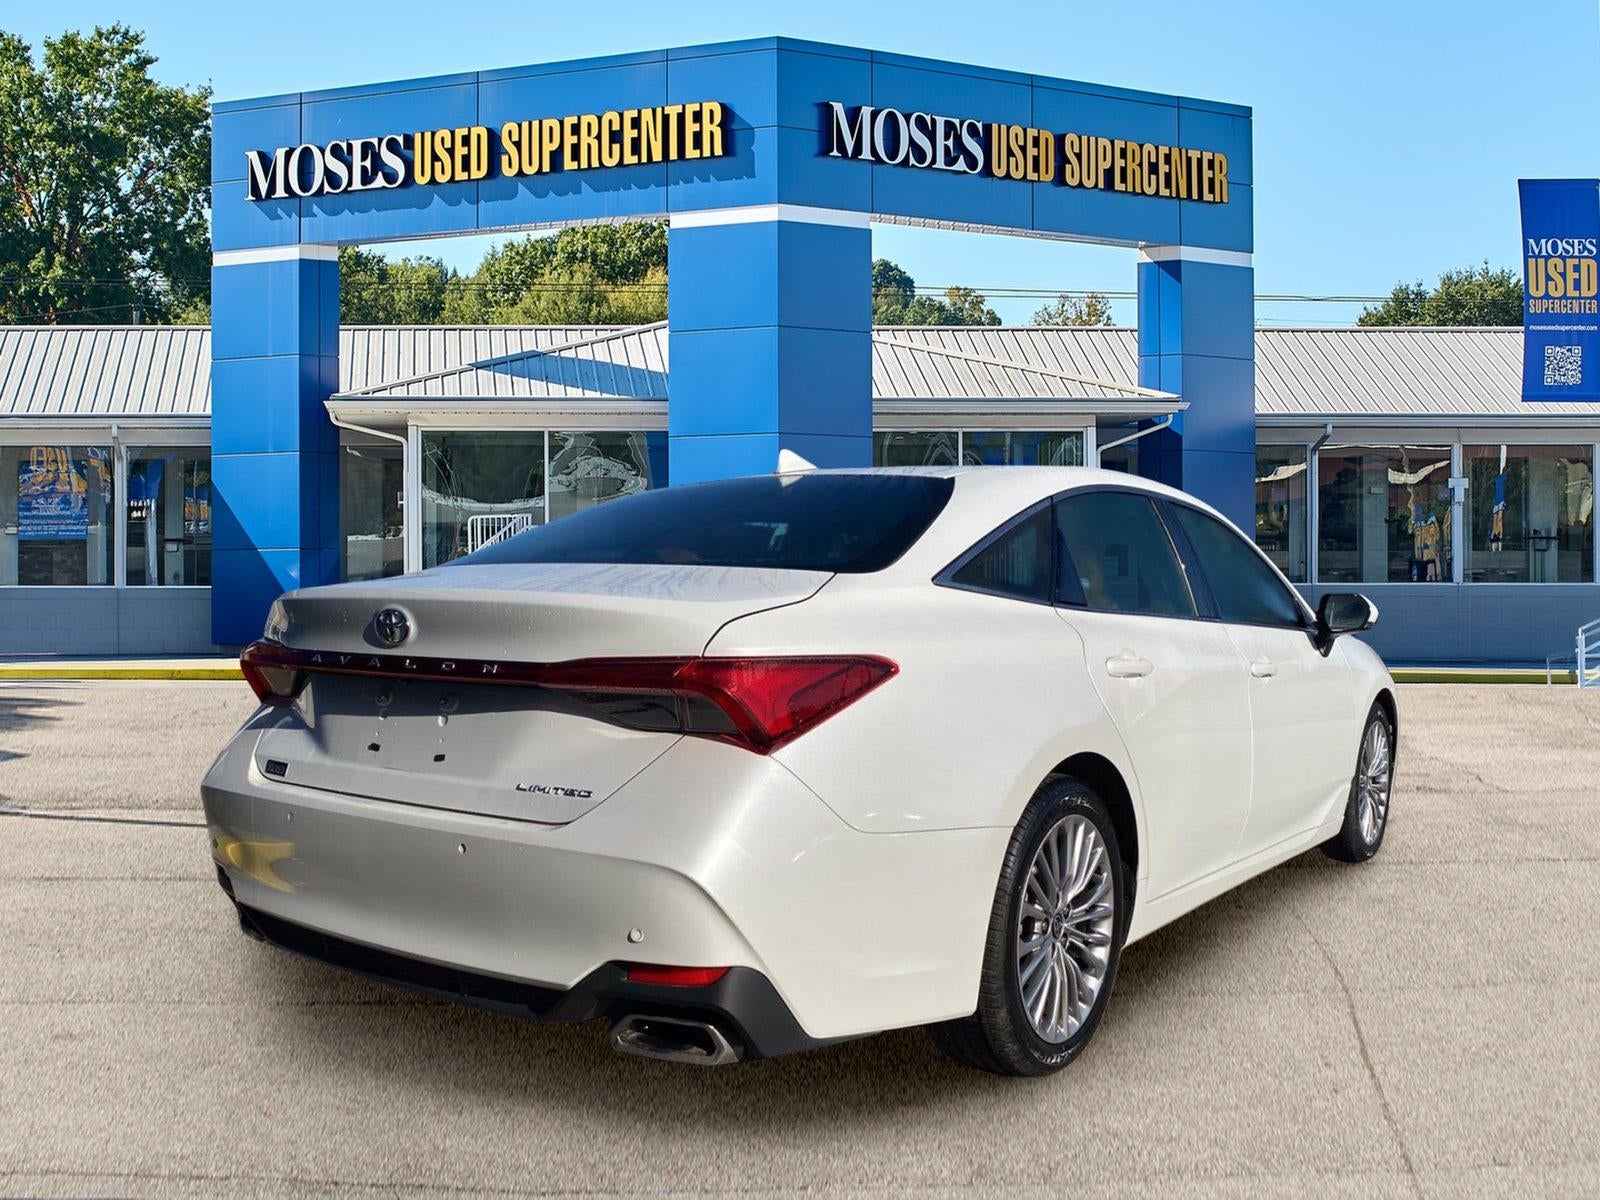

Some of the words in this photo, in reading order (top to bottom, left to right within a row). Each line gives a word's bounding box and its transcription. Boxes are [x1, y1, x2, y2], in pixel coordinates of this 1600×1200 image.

[245, 134, 405, 200] MOSES
[413, 126, 489, 185] USED
[501, 101, 724, 177] SUPERCENTER
[828, 102, 984, 174] MOSES
[991, 122, 1056, 183] USED
[1064, 133, 1229, 203] SUPERCENTER
[1527, 238, 1597, 256] MOSES
[1528, 258, 1597, 297] USED
[1529, 299, 1598, 313] SUPERCENTER
[312, 653, 498, 674] AVALON
[515, 782, 593, 799] LIMITED
